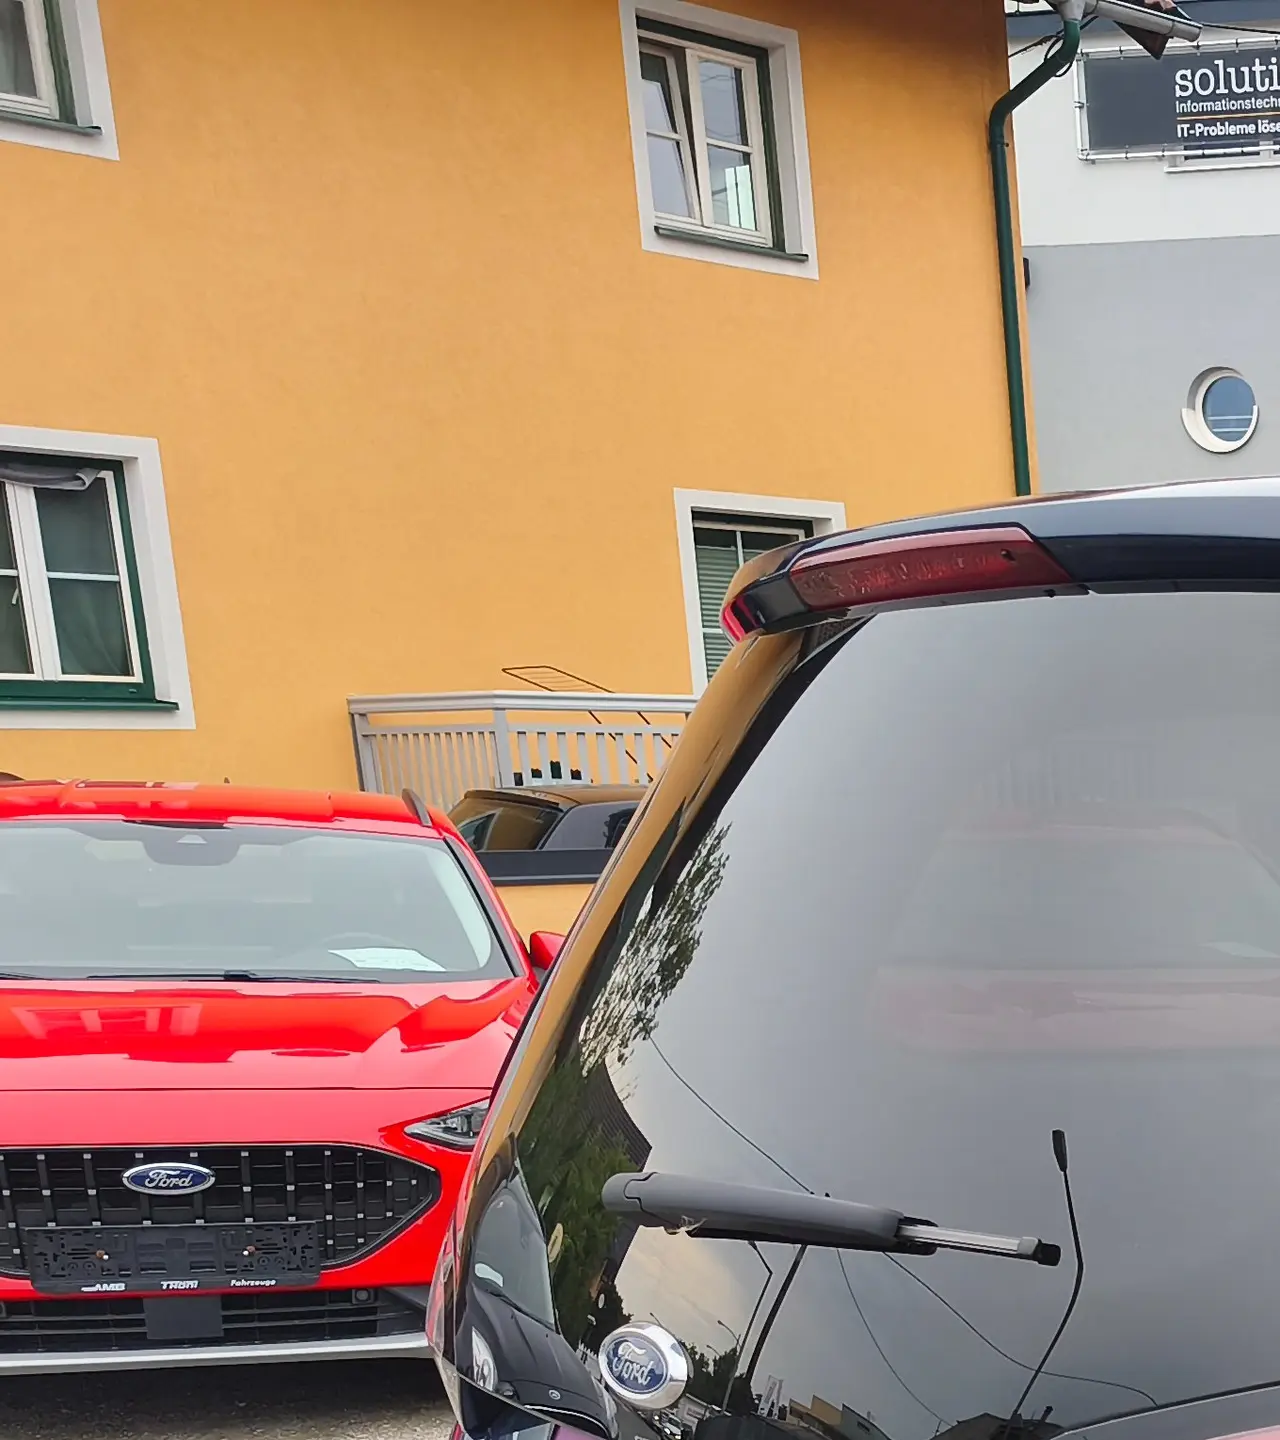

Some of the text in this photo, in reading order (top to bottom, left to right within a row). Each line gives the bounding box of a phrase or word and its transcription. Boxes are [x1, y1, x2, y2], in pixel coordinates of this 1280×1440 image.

[1177, 120, 1257, 138] IT-Probleme
[144, 1169, 194, 1188] Ford
[612, 1341, 655, 1386] Ford
